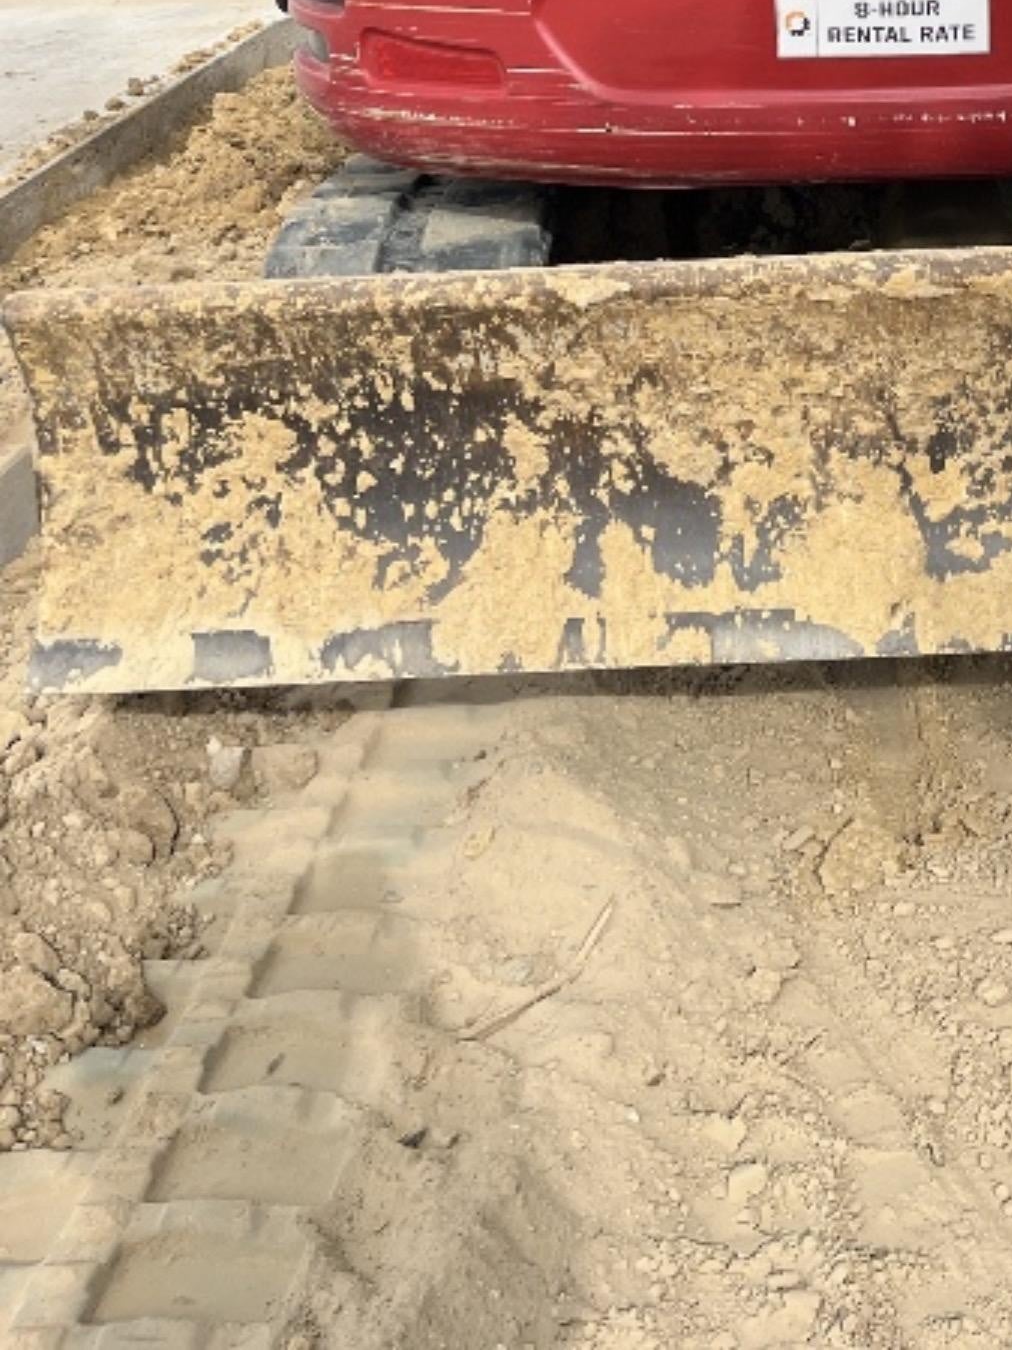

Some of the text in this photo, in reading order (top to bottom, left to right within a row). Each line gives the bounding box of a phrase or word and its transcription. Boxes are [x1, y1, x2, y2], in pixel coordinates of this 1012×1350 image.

[853, 0, 941, 19] 8-HOUR
[826, 23, 977, 44] RENTAL RATE
